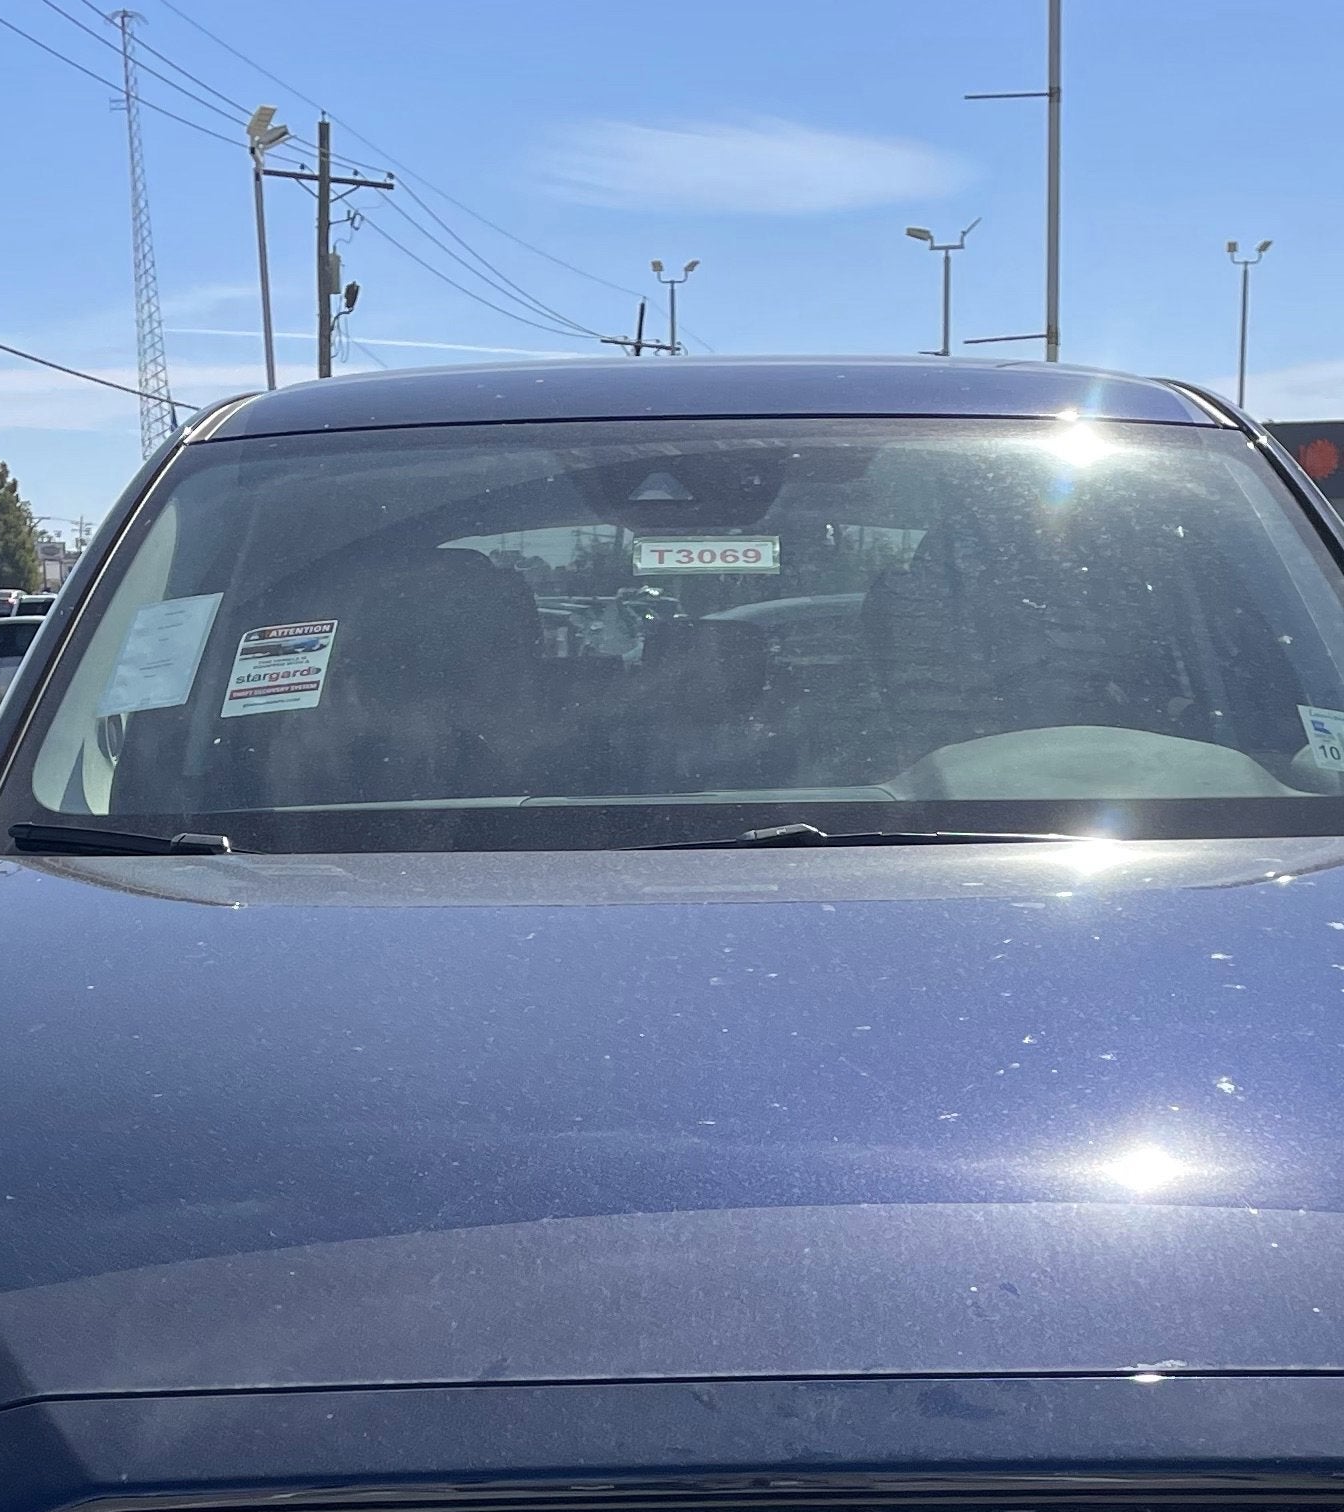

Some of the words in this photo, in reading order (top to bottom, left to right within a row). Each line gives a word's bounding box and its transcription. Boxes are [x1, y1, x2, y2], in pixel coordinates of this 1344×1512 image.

[650, 548, 762, 564] T3069
[269, 624, 331, 638] ATTENTION
[236, 666, 312, 684] stargard
[1319, 745, 1341, 760] 10
